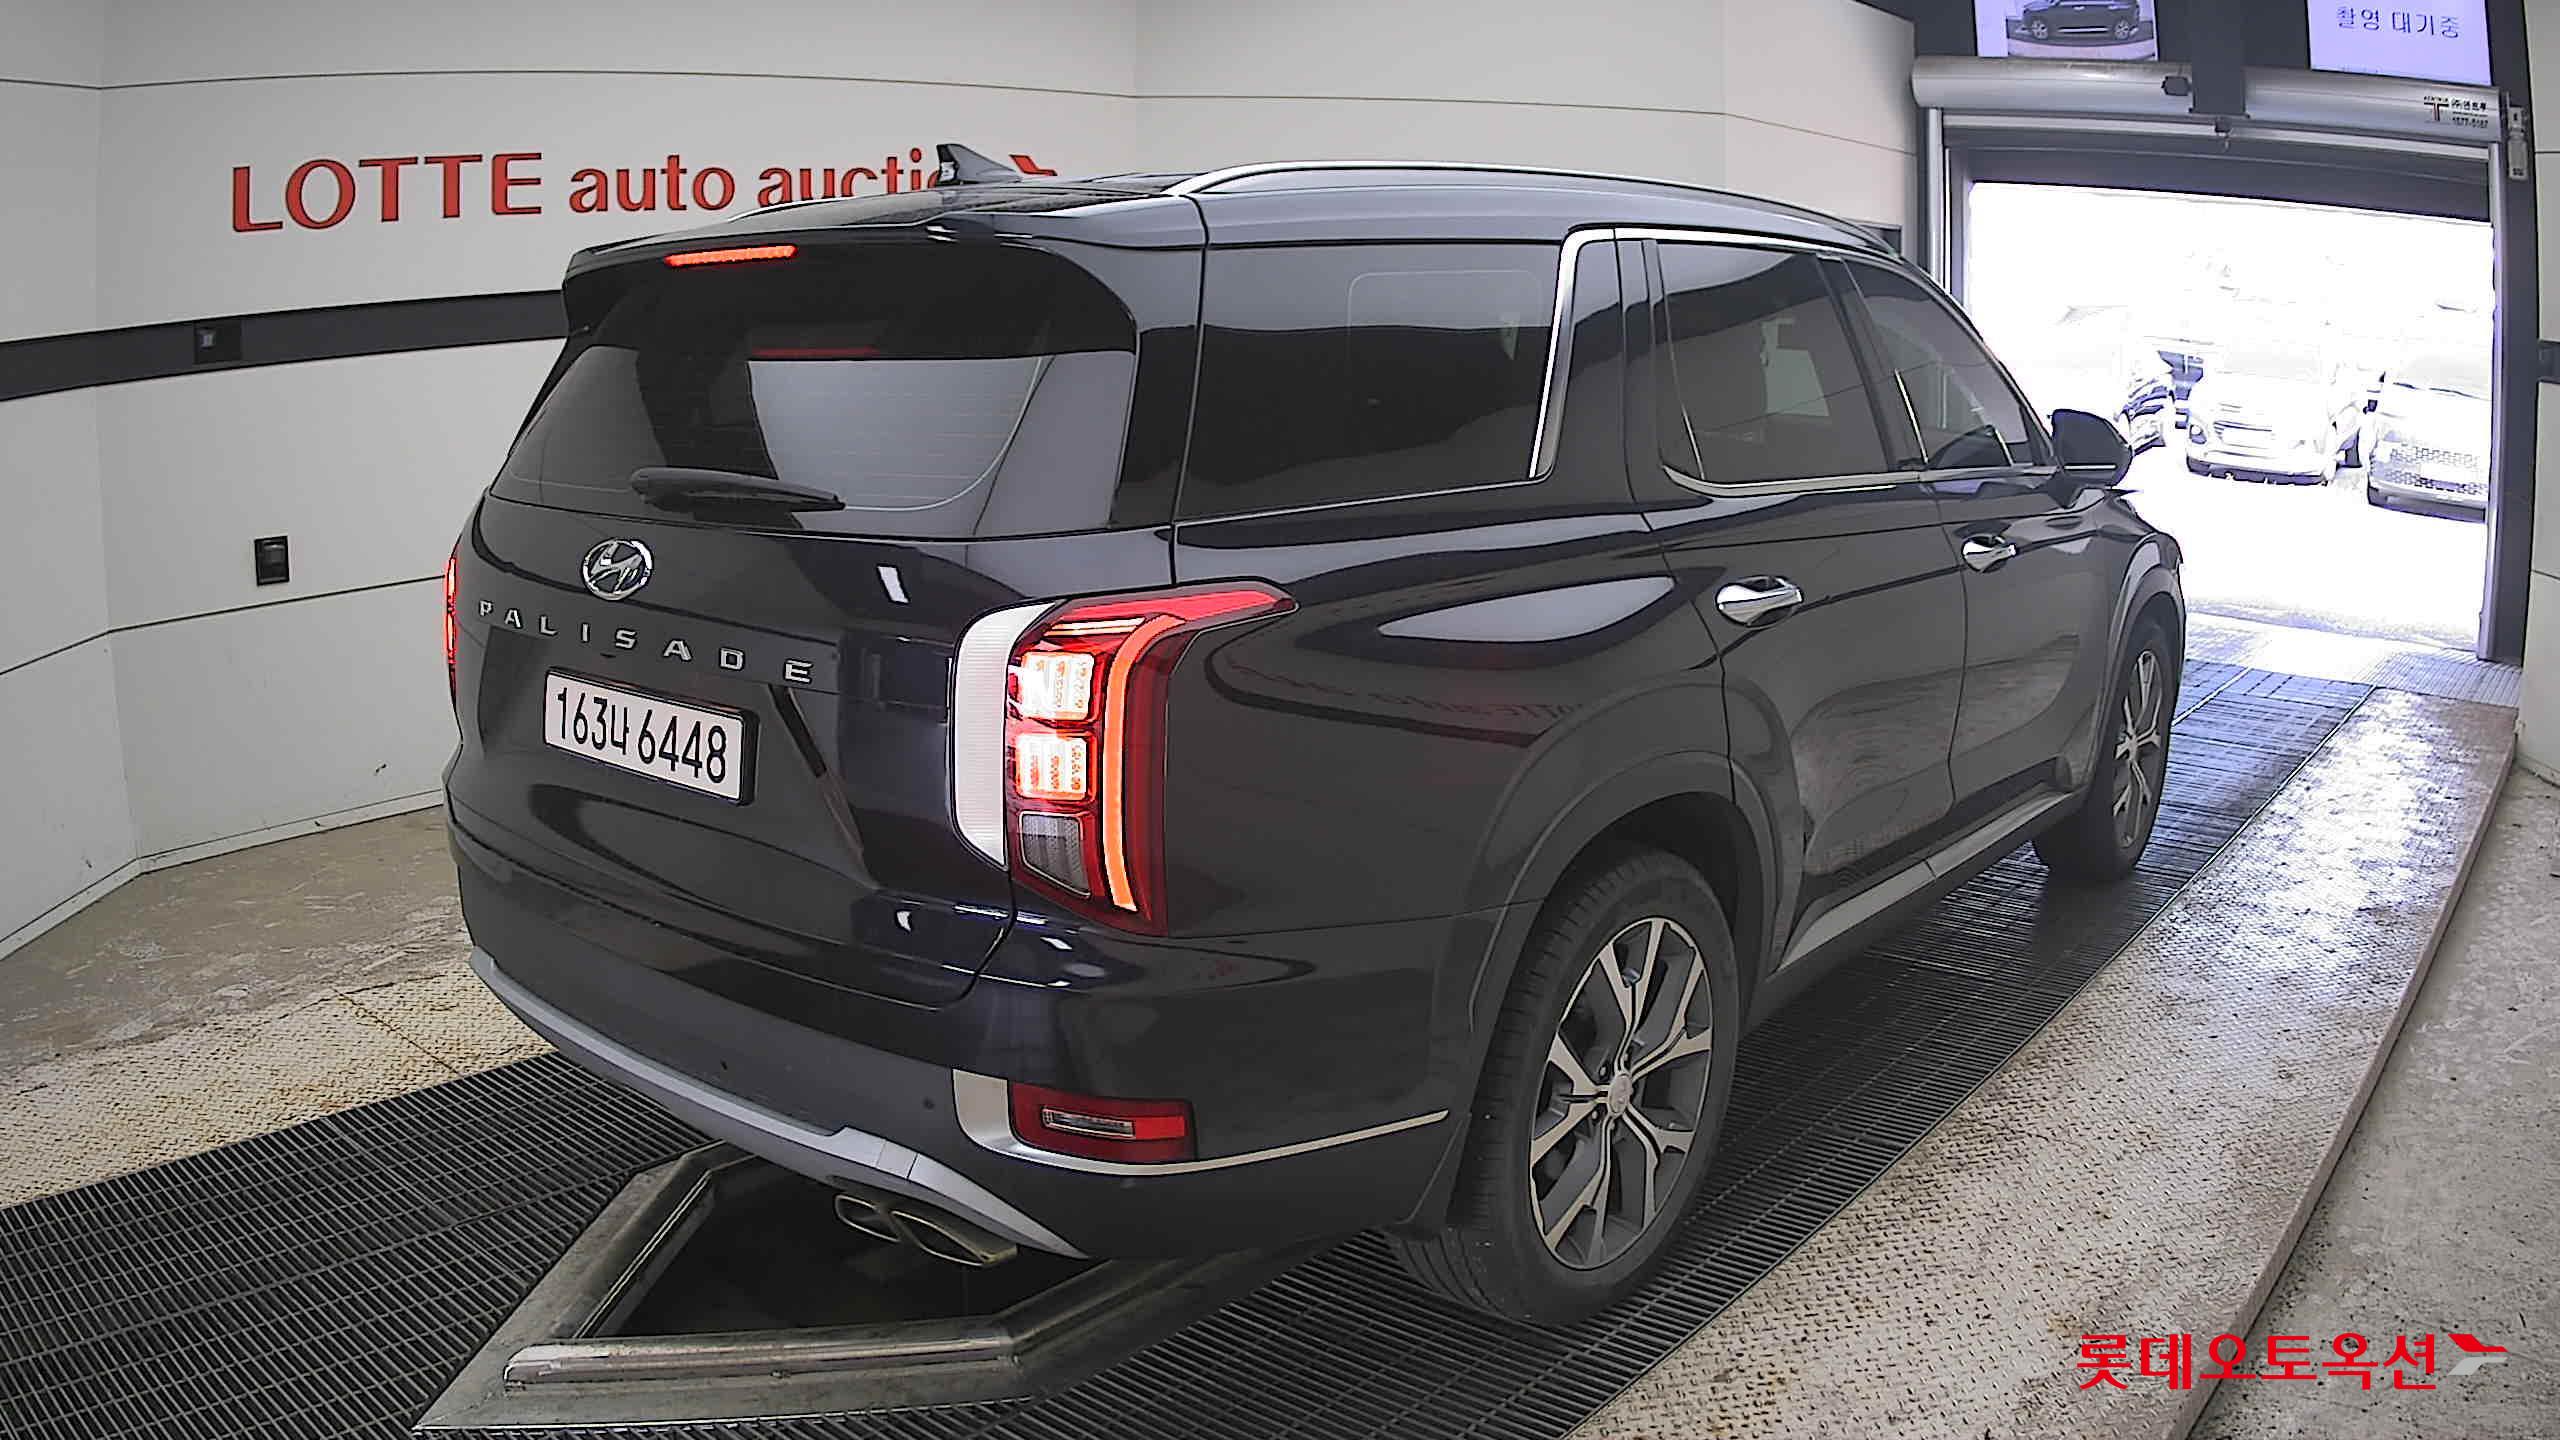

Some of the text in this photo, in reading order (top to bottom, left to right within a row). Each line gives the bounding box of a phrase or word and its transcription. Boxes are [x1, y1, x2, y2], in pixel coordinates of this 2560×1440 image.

[2338, 6, 2460, 39] 촬영 대기중
[233, 152, 541, 233] LOTTE
[569, 154, 736, 214] auto
[479, 601, 814, 684] PALISADE
